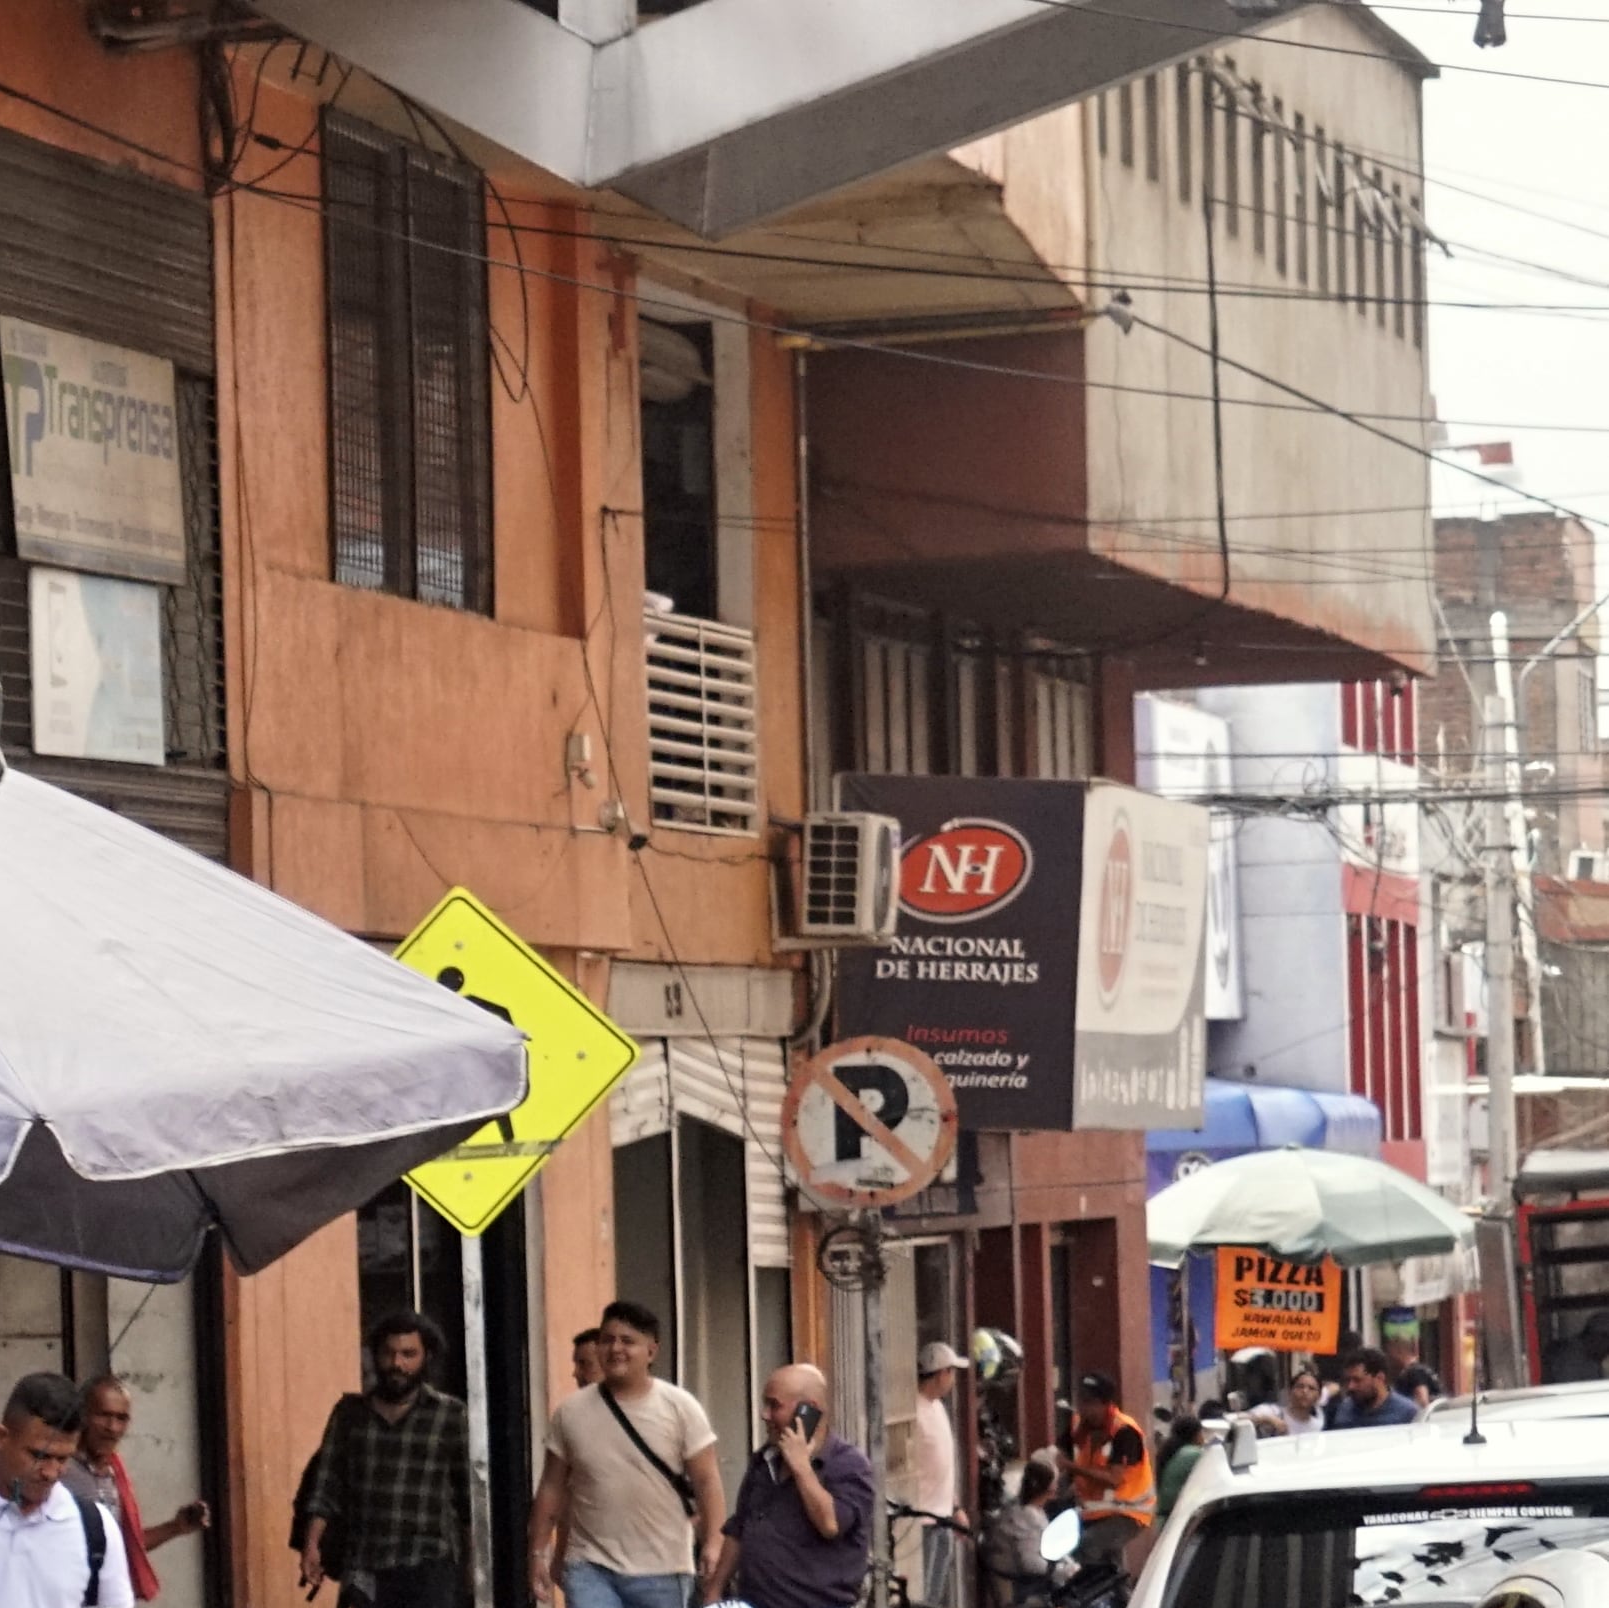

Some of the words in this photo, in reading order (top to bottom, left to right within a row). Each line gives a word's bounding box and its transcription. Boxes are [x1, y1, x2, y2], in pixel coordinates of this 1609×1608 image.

[43, 362, 175, 467] Transprensa
[918, 844, 1005, 895] NH
[890, 935, 1026, 959] NACIONAL
[875, 959, 910, 980] DE
[916, 961, 1039, 986] HERRAJES
[906, 1024, 1008, 1046] Insumos
[934, 1050, 1011, 1067] calzado
[1015, 1053, 1030, 1071] y
[946, 1070, 1029, 1090] quinería
[1234, 1255, 1324, 1287] PIZZA
[1469, 1507, 1518, 1519] SIEMPRE
